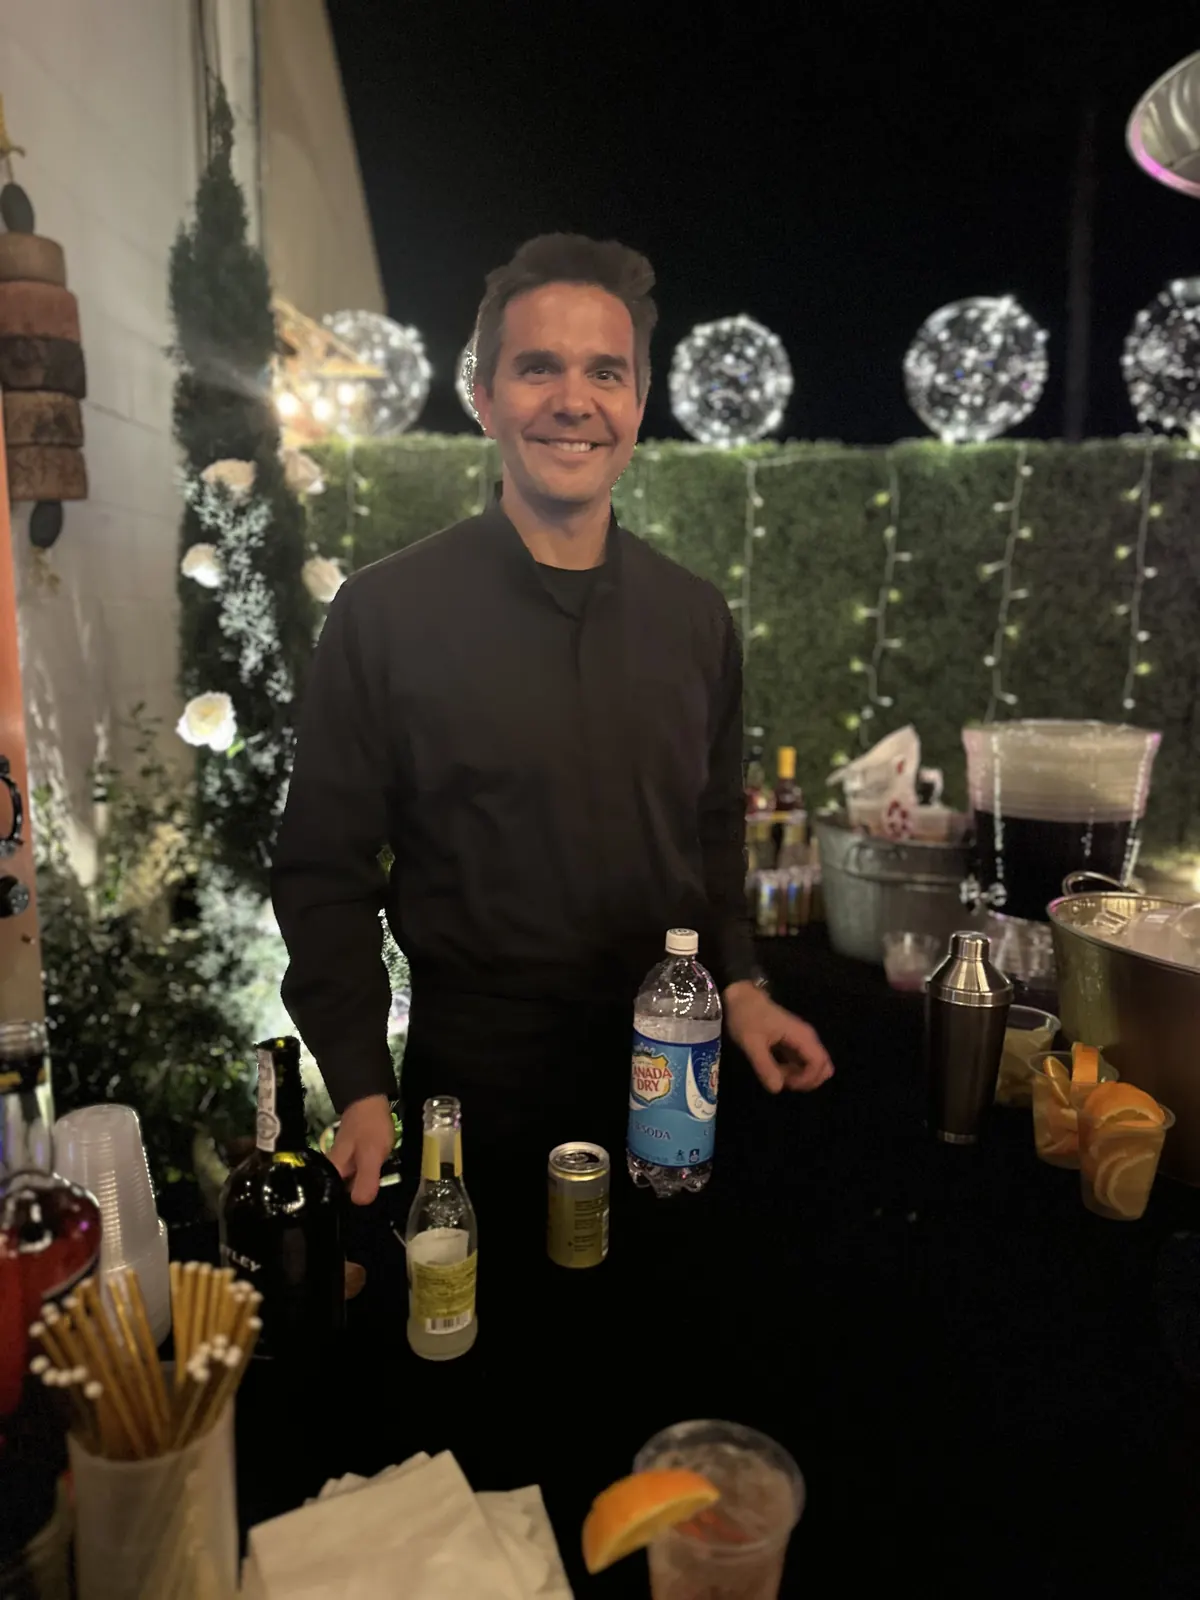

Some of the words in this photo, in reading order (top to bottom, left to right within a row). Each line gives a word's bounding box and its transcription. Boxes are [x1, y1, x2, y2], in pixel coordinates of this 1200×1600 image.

[632, 1063, 673, 1079] ANADA
[637, 1078, 660, 1092] DRY
[641, 1124, 671, 1140] SODA
